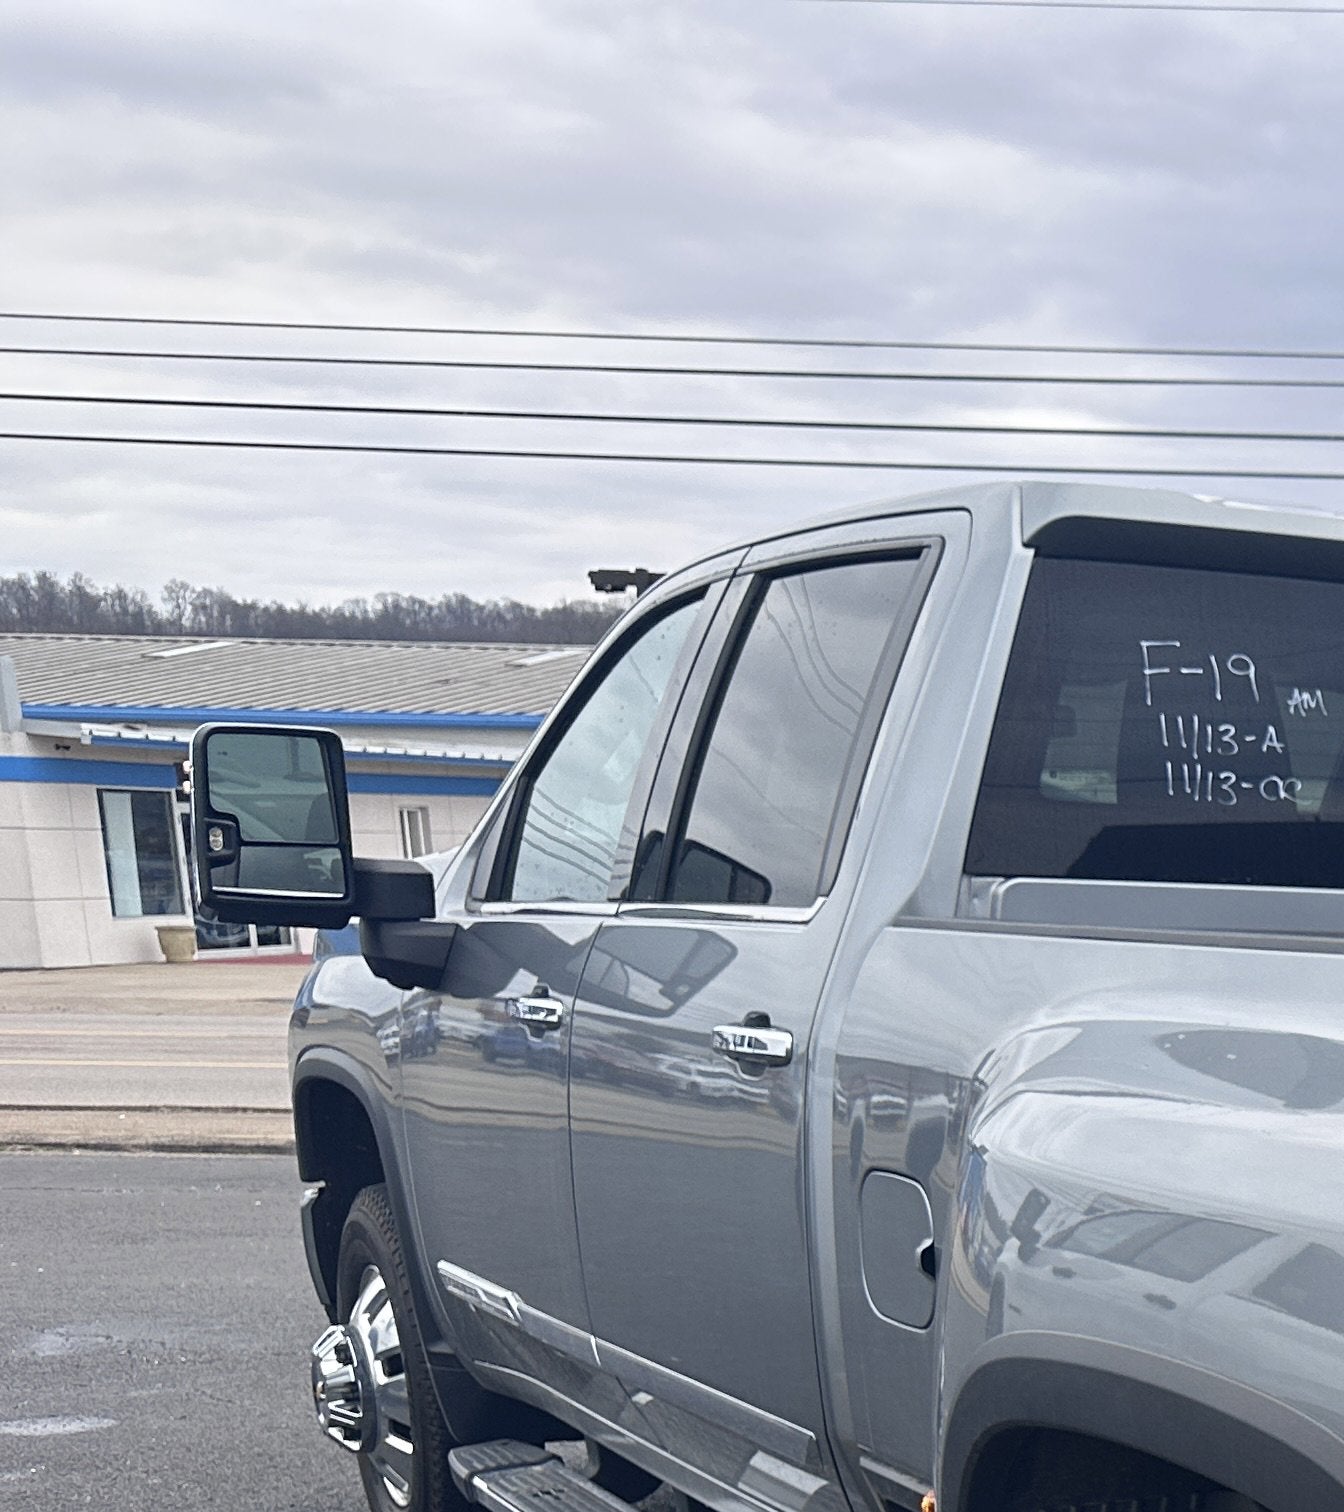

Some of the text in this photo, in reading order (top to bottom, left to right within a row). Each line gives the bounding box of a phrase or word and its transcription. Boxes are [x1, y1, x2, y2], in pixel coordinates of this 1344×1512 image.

[1140, 640, 1260, 706] F-19
[1287, 687, 1328, 718] AM
[1159, 711, 1286, 760] 11/13-A
